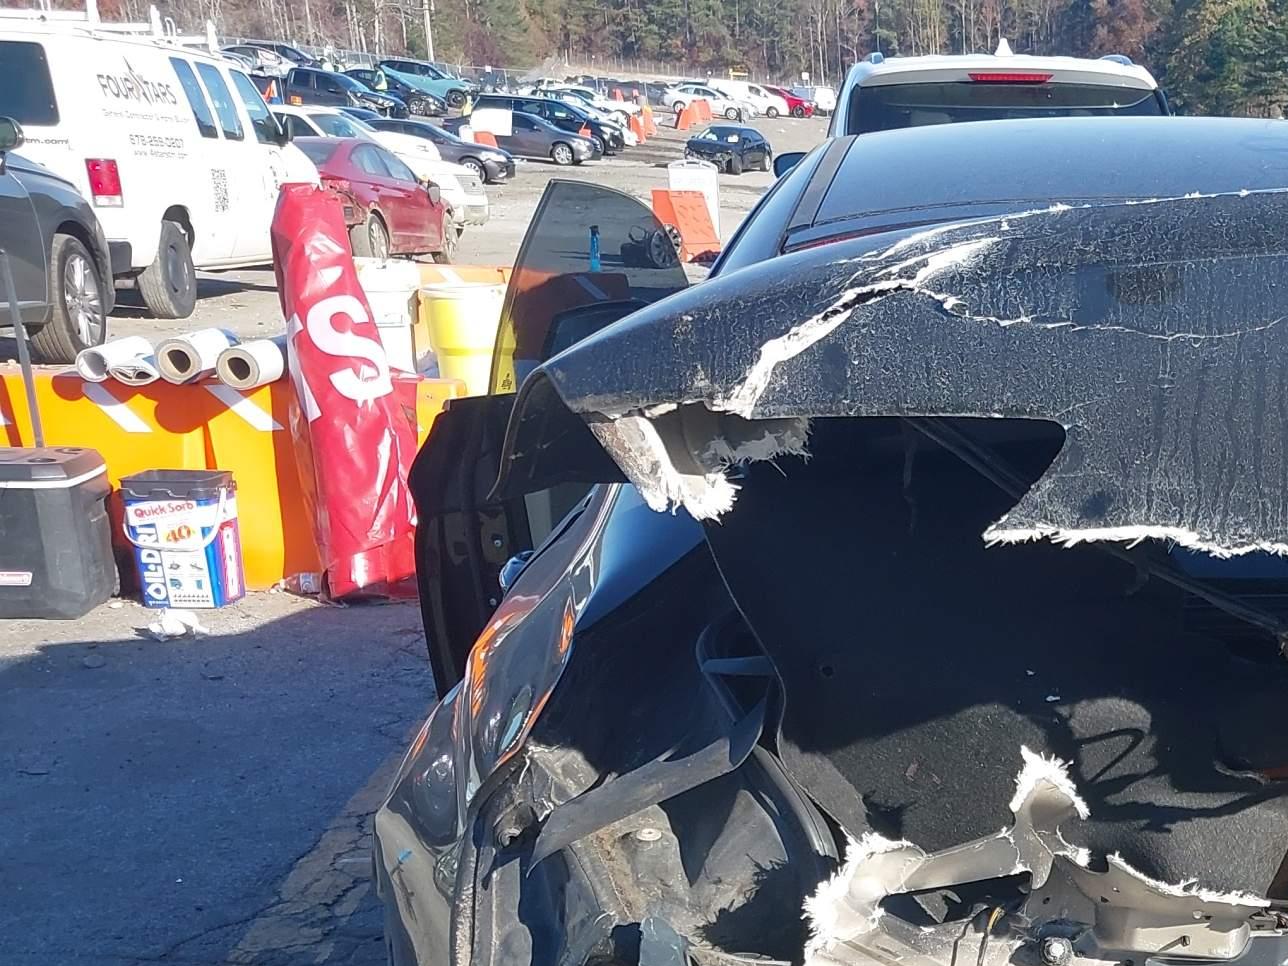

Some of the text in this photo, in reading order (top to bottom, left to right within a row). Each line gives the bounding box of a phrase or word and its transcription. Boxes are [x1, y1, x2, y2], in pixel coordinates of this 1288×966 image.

[97, 73, 138, 100] FOUR
[134, 502, 195, 519] Quick Sorb
